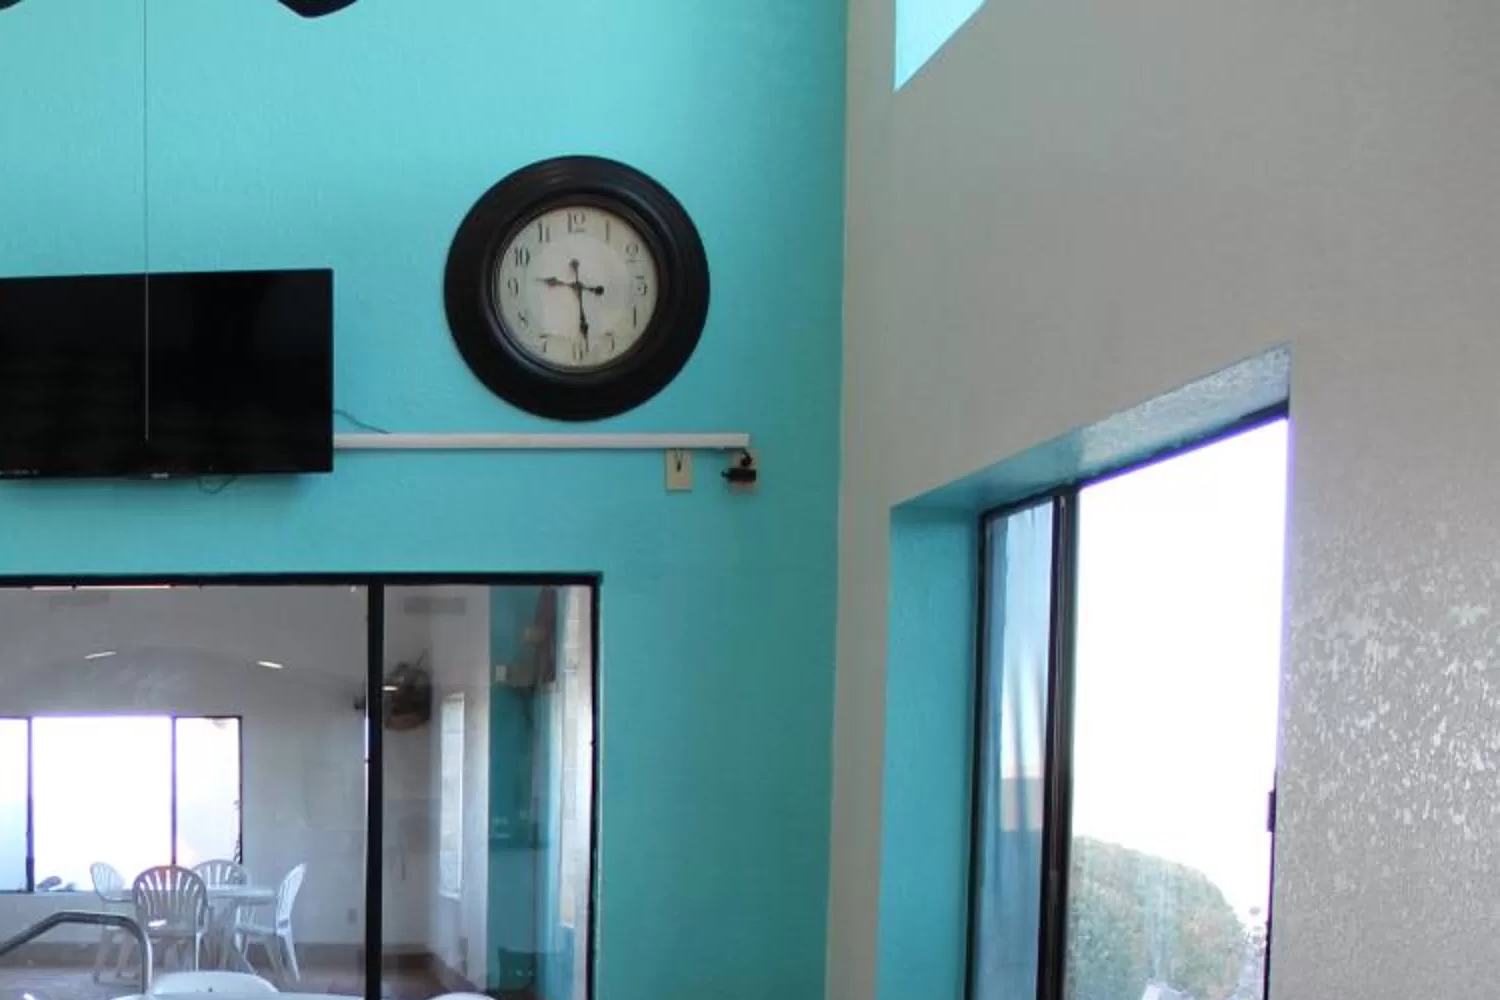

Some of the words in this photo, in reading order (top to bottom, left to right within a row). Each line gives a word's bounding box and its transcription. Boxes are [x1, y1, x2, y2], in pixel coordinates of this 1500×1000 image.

[537, 219, 550, 243] 11
[567, 211, 587, 233] 12
[604, 219, 611, 242] 1
[513, 246, 531, 268] 10
[507, 277, 519, 299] 9
